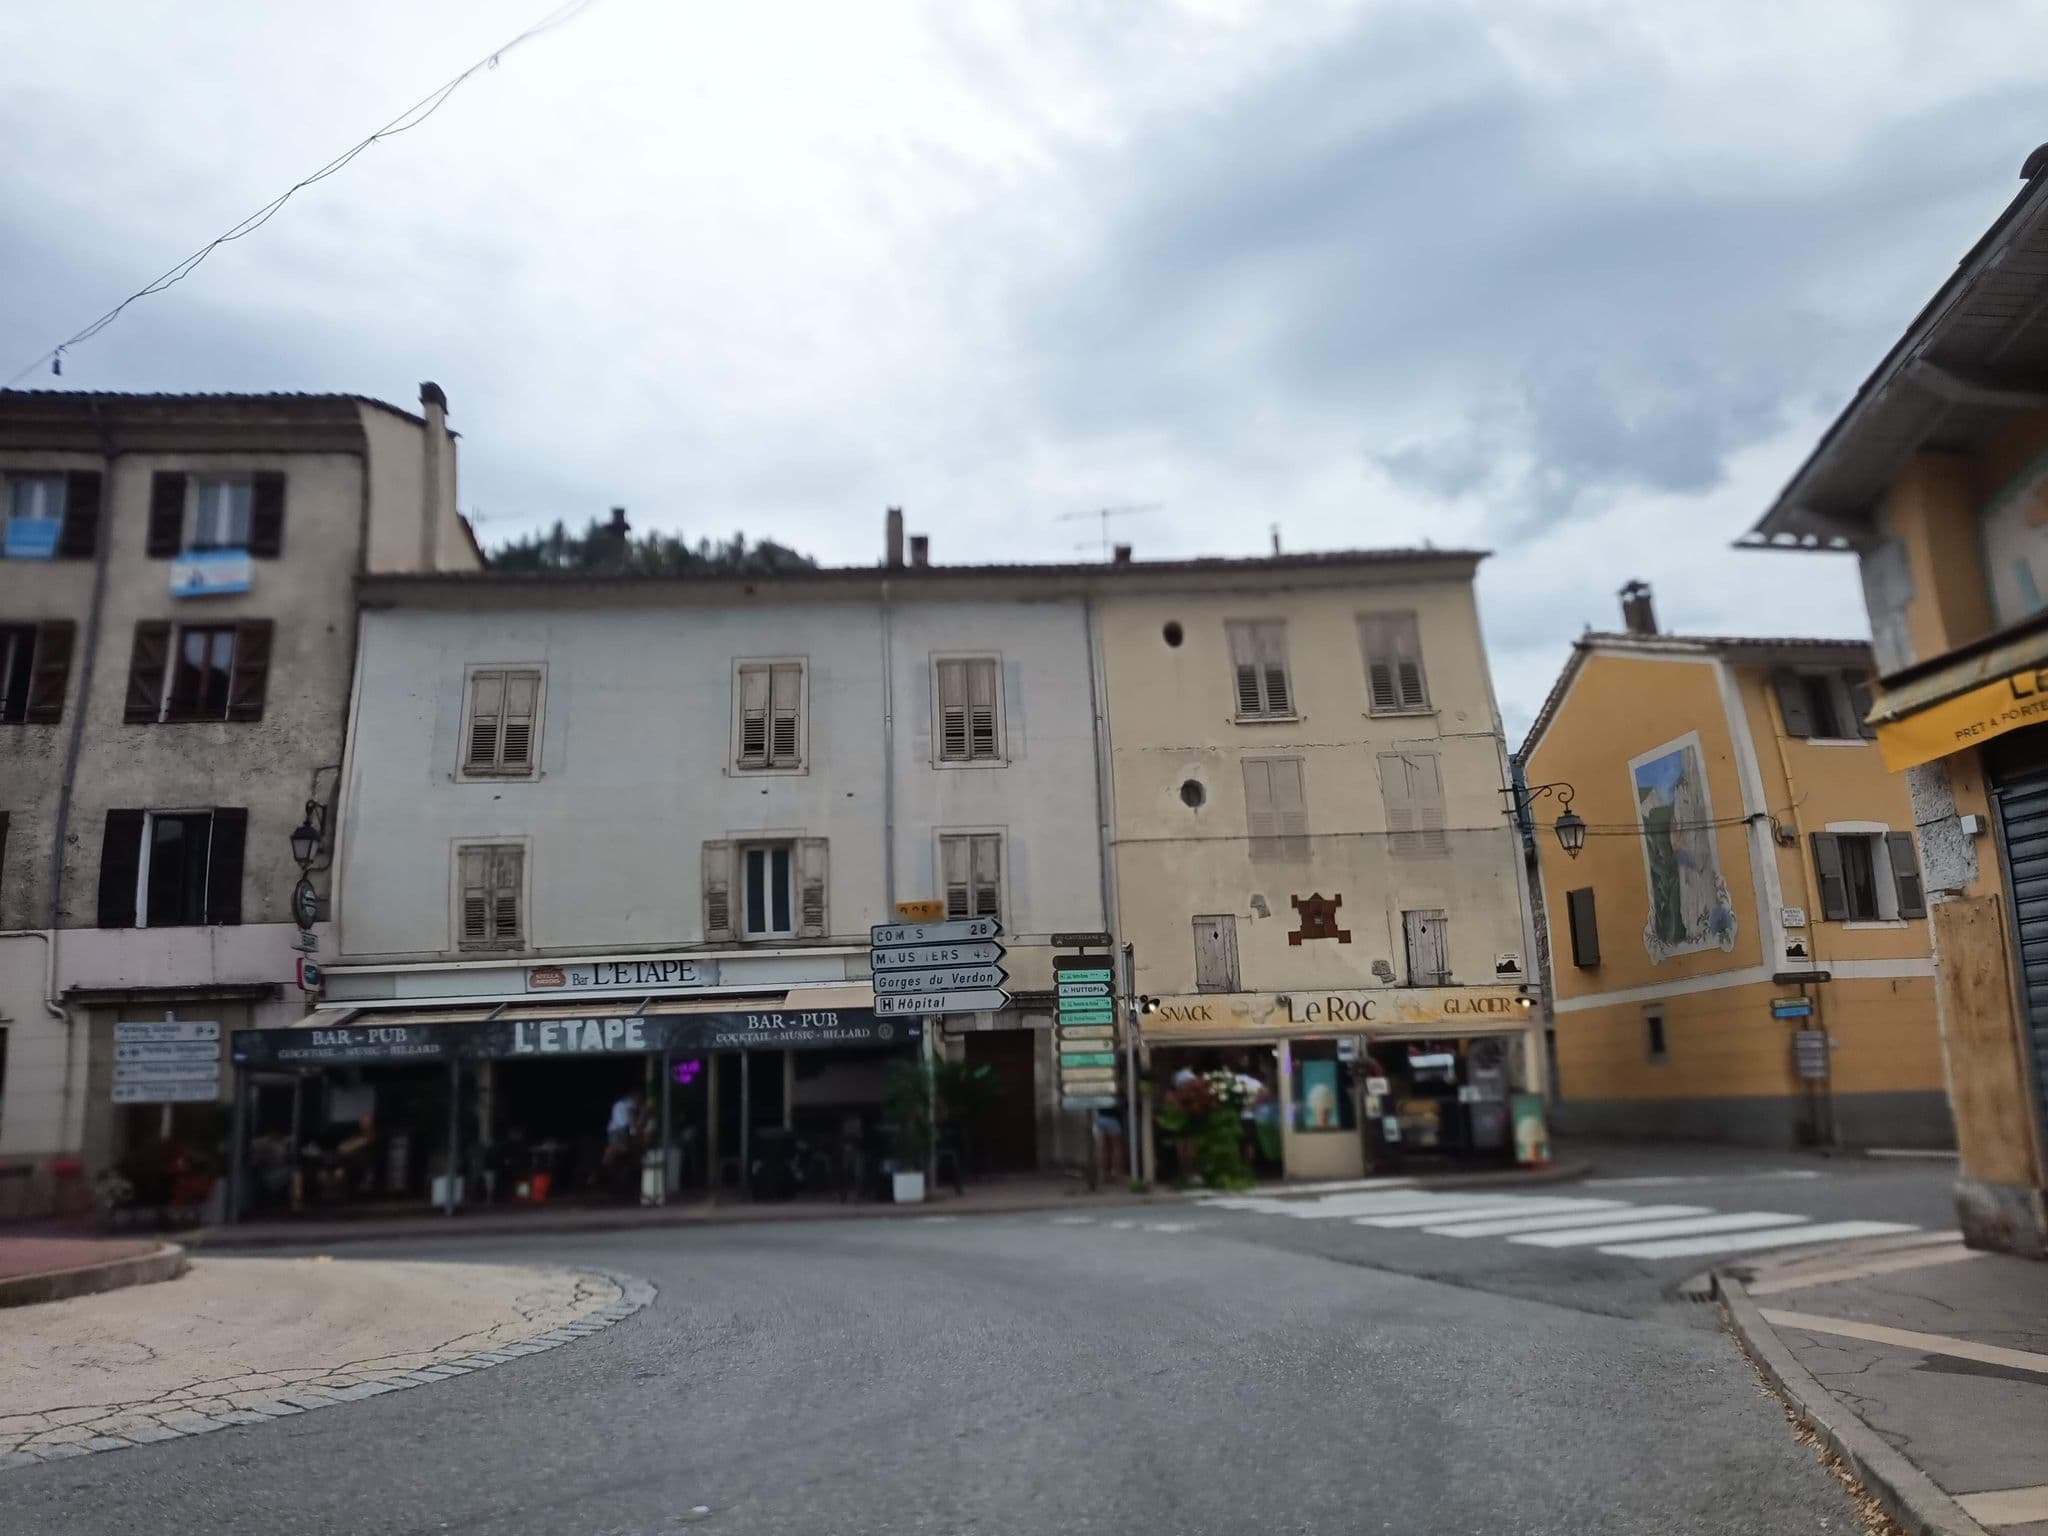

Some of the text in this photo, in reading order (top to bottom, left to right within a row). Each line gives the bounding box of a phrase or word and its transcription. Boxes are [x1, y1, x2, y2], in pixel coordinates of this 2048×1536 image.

[1955, 721, 1986, 741] PRET
[876, 923, 988, 942] COMS 28
[572, 960, 696, 986] Bar L'ETAPE
[879, 971, 993, 990] Gorges du Verdon
[898, 996, 945, 1011] Hôpital
[1160, 1003, 1213, 1022] SNACK
[1287, 997, 1321, 1024] Le
[1443, 997, 1512, 1015] GLACIER
[747, 1012, 839, 1029] BAR PUB
[312, 1027, 408, 1046] BAR PUB
[514, 1017, 647, 1053] L'ETAPE
[716, 1031, 772, 1043] COCKTAIL
[780, 1029, 815, 1041] MUSIC
